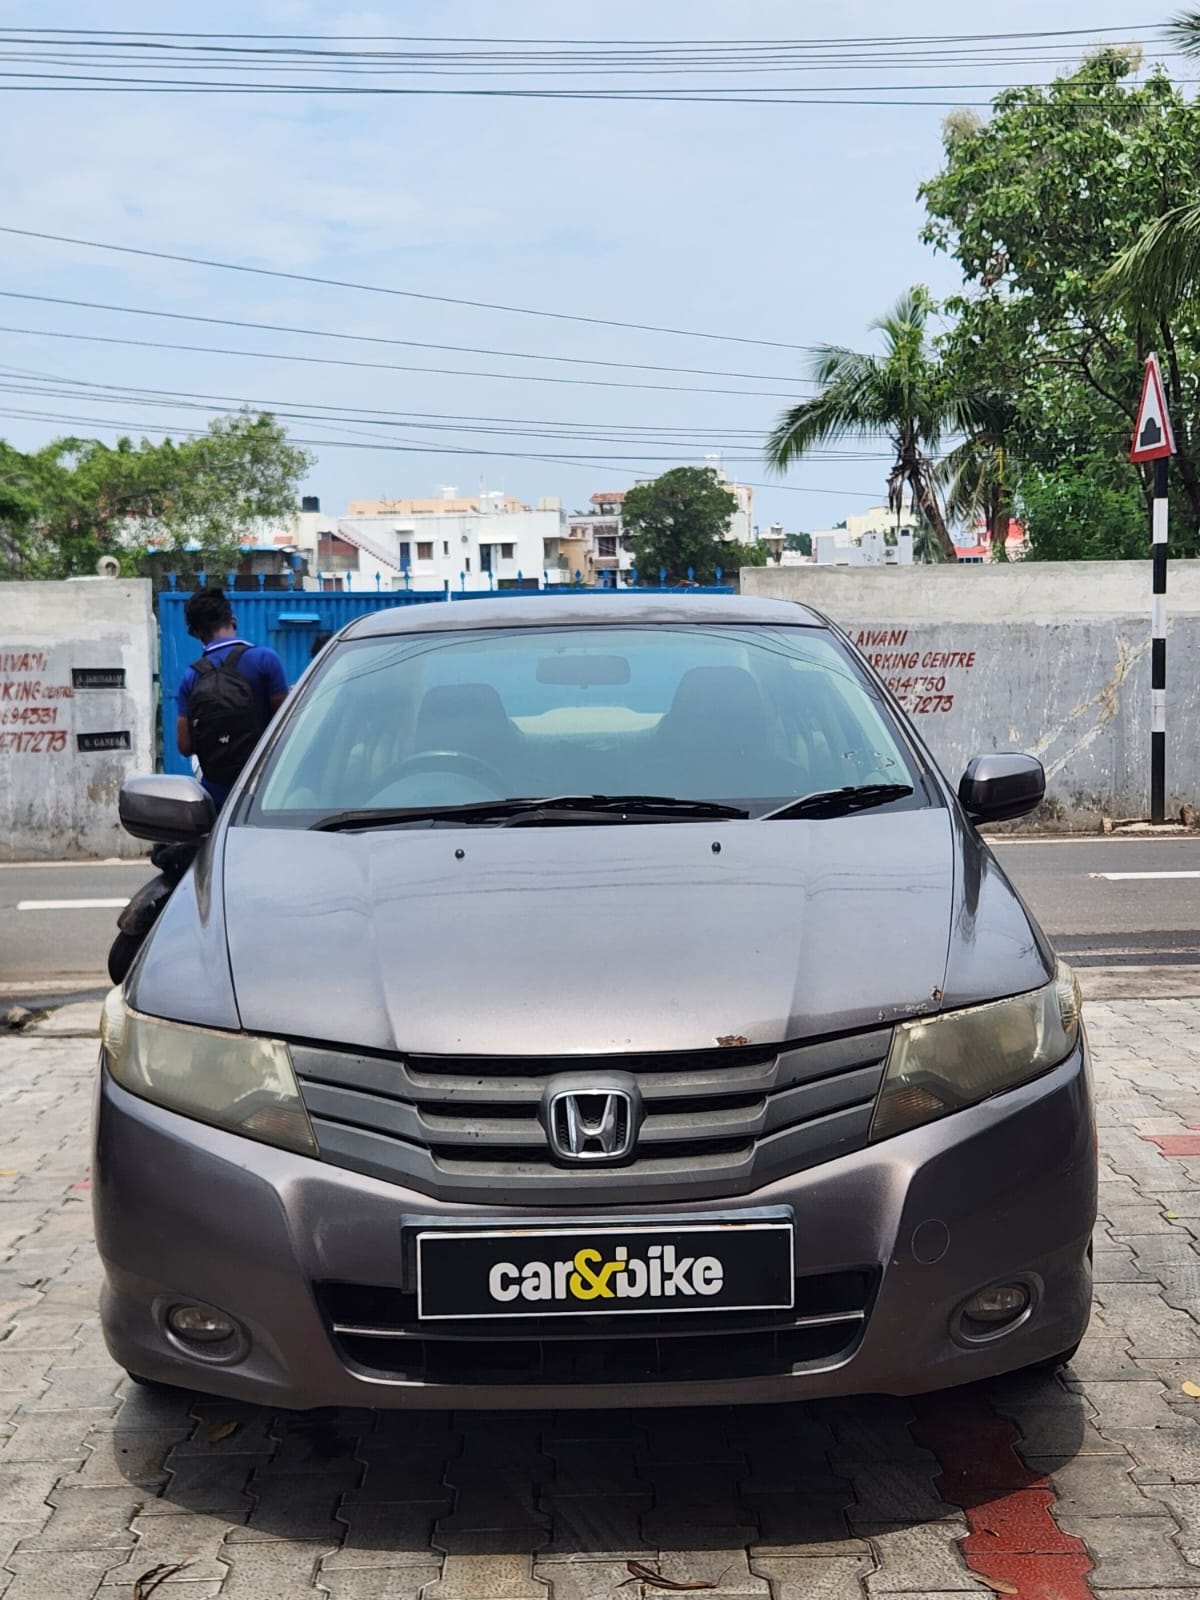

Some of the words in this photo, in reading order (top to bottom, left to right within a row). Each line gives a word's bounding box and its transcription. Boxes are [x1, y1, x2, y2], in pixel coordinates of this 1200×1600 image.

[847, 630, 908, 647] AIVANI
[0, 653, 48, 672] IVANI
[867, 652, 920, 670] ARKING
[922, 652, 976, 668] CENTRE
[0, 680, 41, 701] KING
[488, 1245, 724, 1302] car&bike
